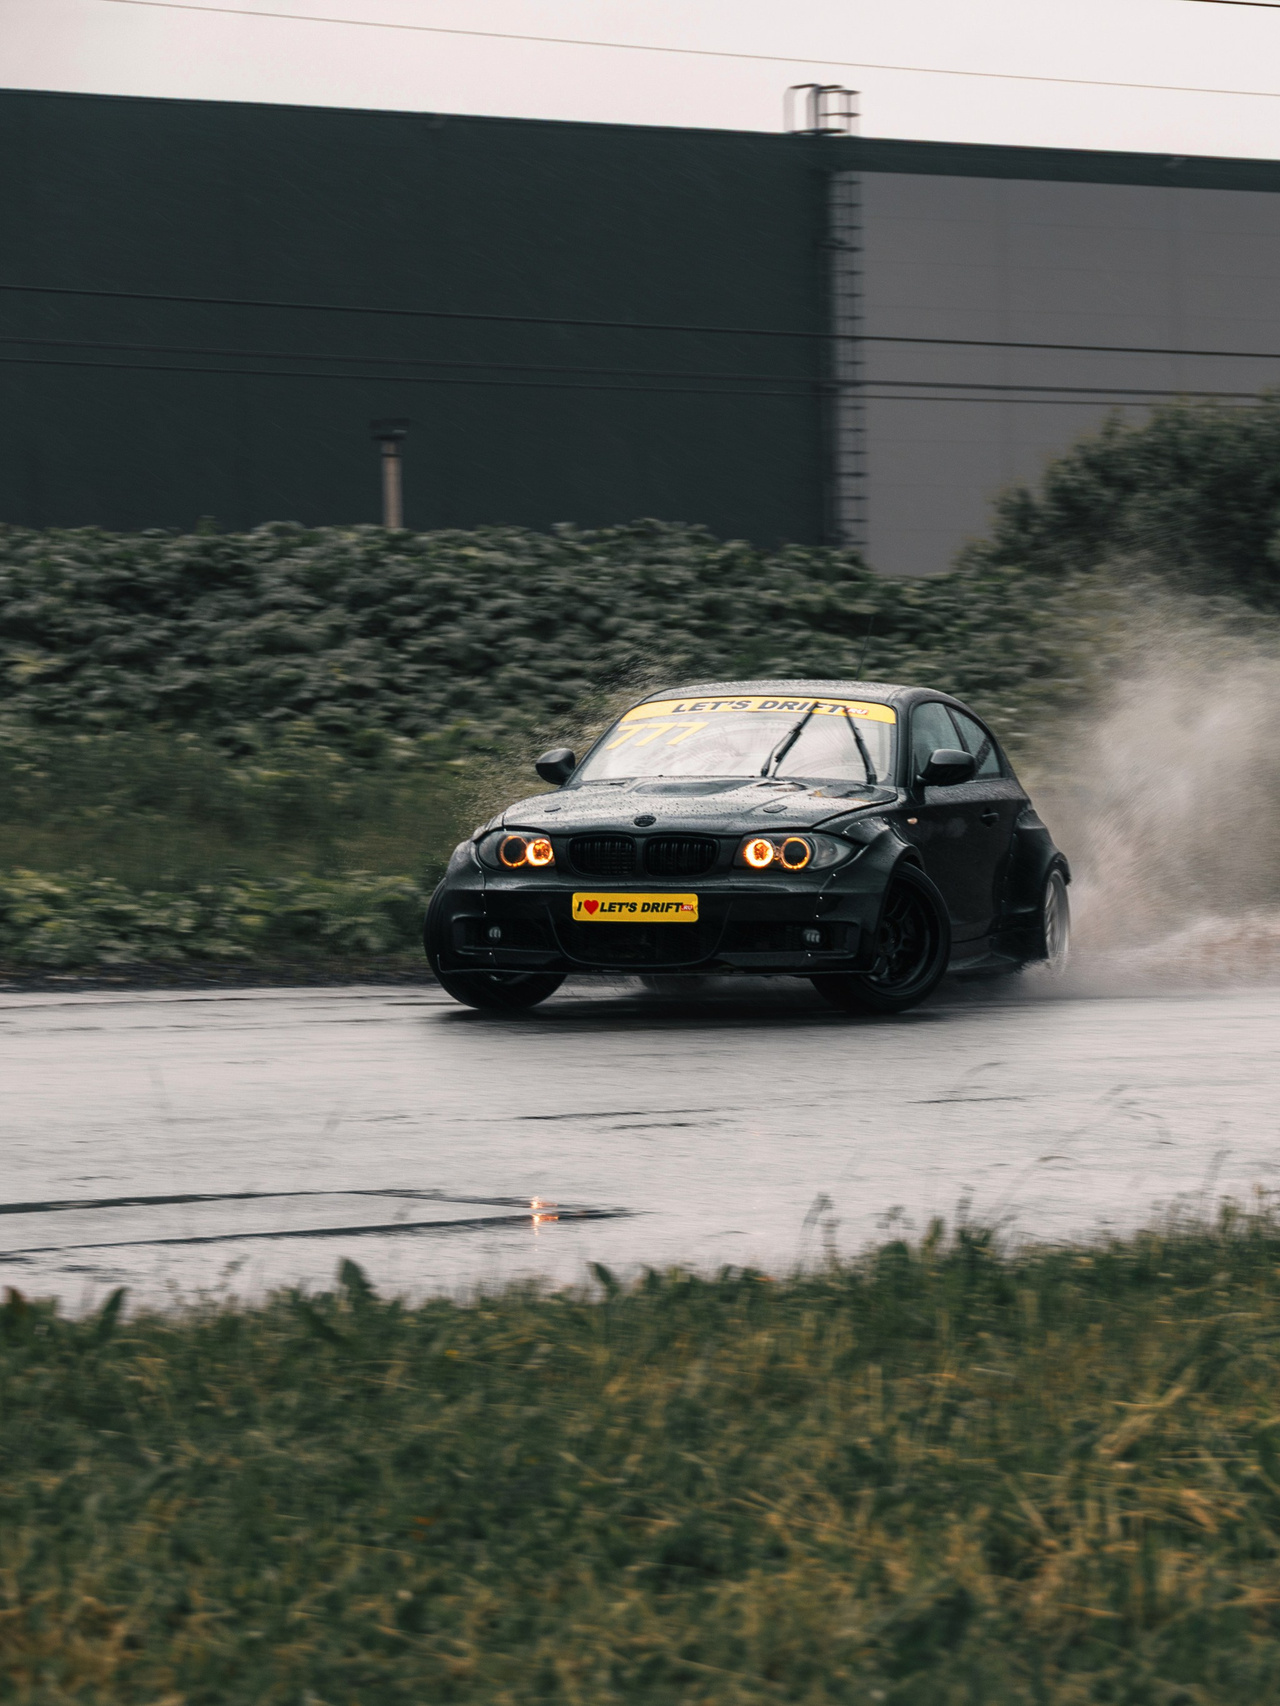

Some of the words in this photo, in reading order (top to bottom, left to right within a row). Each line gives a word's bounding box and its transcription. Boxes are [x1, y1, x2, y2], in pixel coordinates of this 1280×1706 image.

[672, 700, 752, 713] LET'S
[606, 722, 708, 750] 777
[599, 902, 638, 912] LET'S
